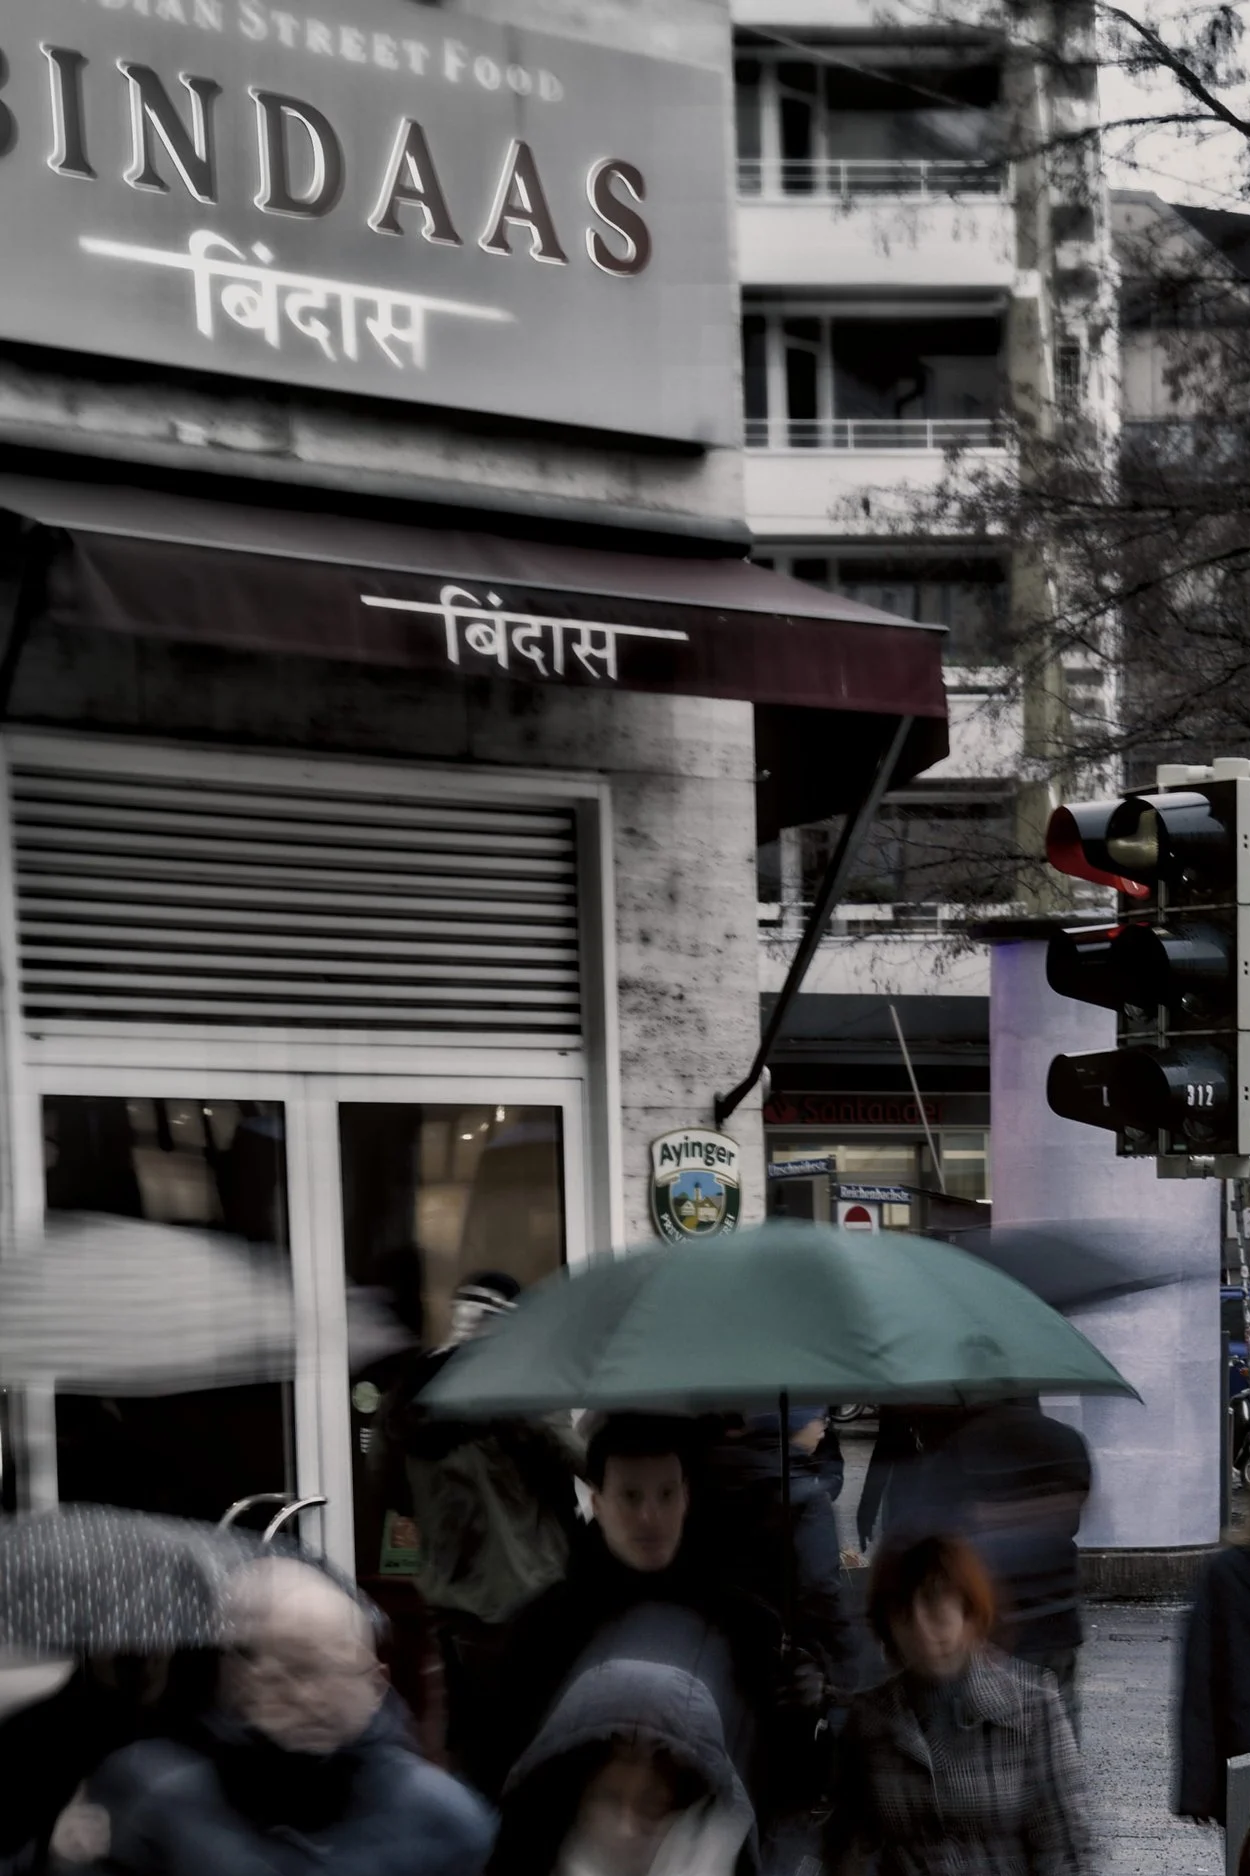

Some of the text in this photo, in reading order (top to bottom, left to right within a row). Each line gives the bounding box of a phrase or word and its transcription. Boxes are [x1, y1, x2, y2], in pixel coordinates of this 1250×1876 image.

[443, 38, 563, 101] FOOD
[0, 42, 653, 278] INDAAS
[78, 229, 517, 371] बिंदास
[360, 585, 690, 681] बिंदास
[1186, 1084, 1214, 1107] 312
[659, 1136, 736, 1167] Ayinger
